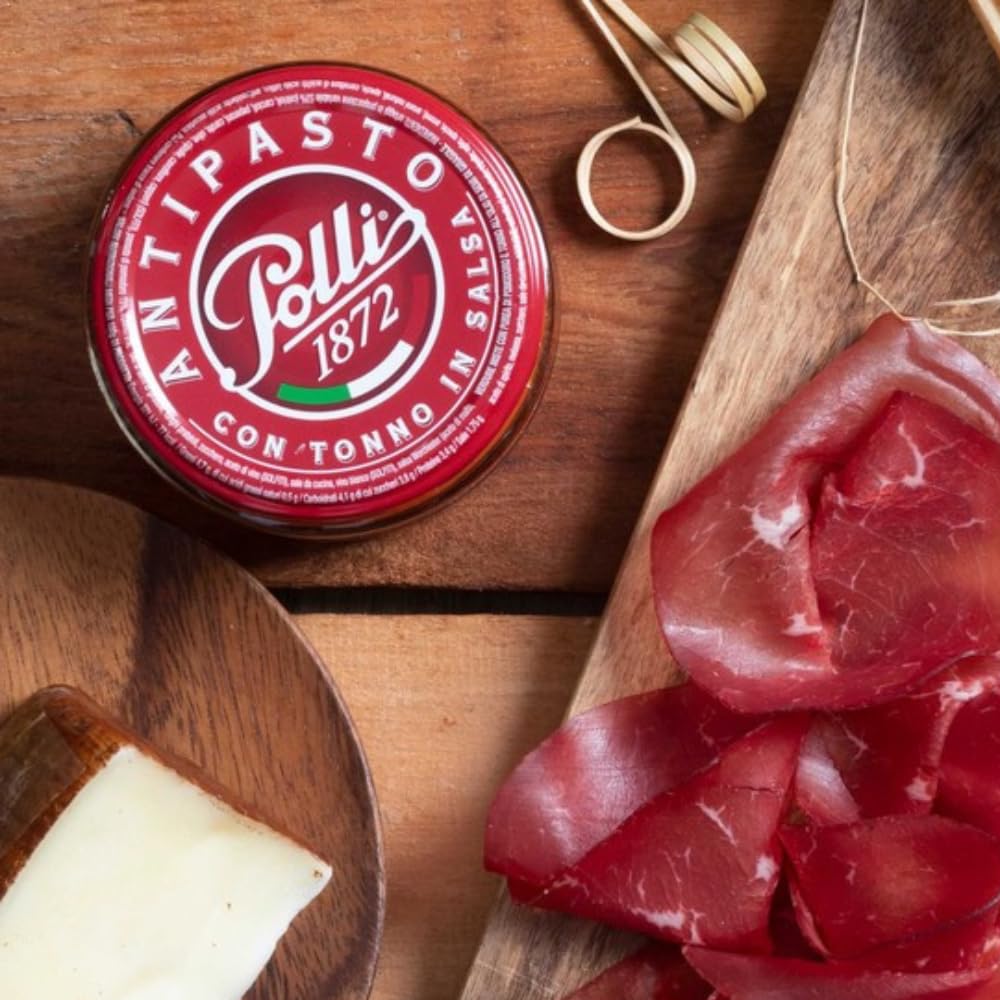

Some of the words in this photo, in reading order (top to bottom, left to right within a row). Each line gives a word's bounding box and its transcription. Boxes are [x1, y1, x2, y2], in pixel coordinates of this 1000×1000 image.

[138, 110, 445, 388] ANTIPASTO
[203, 200, 427, 391] Polli
[450, 205, 492, 334] SALSA
[311, 283, 399, 382] 1872
[438, 349, 477, 395] IN
[213, 409, 289, 461] CON
[308, 402, 435, 465] TONNO
